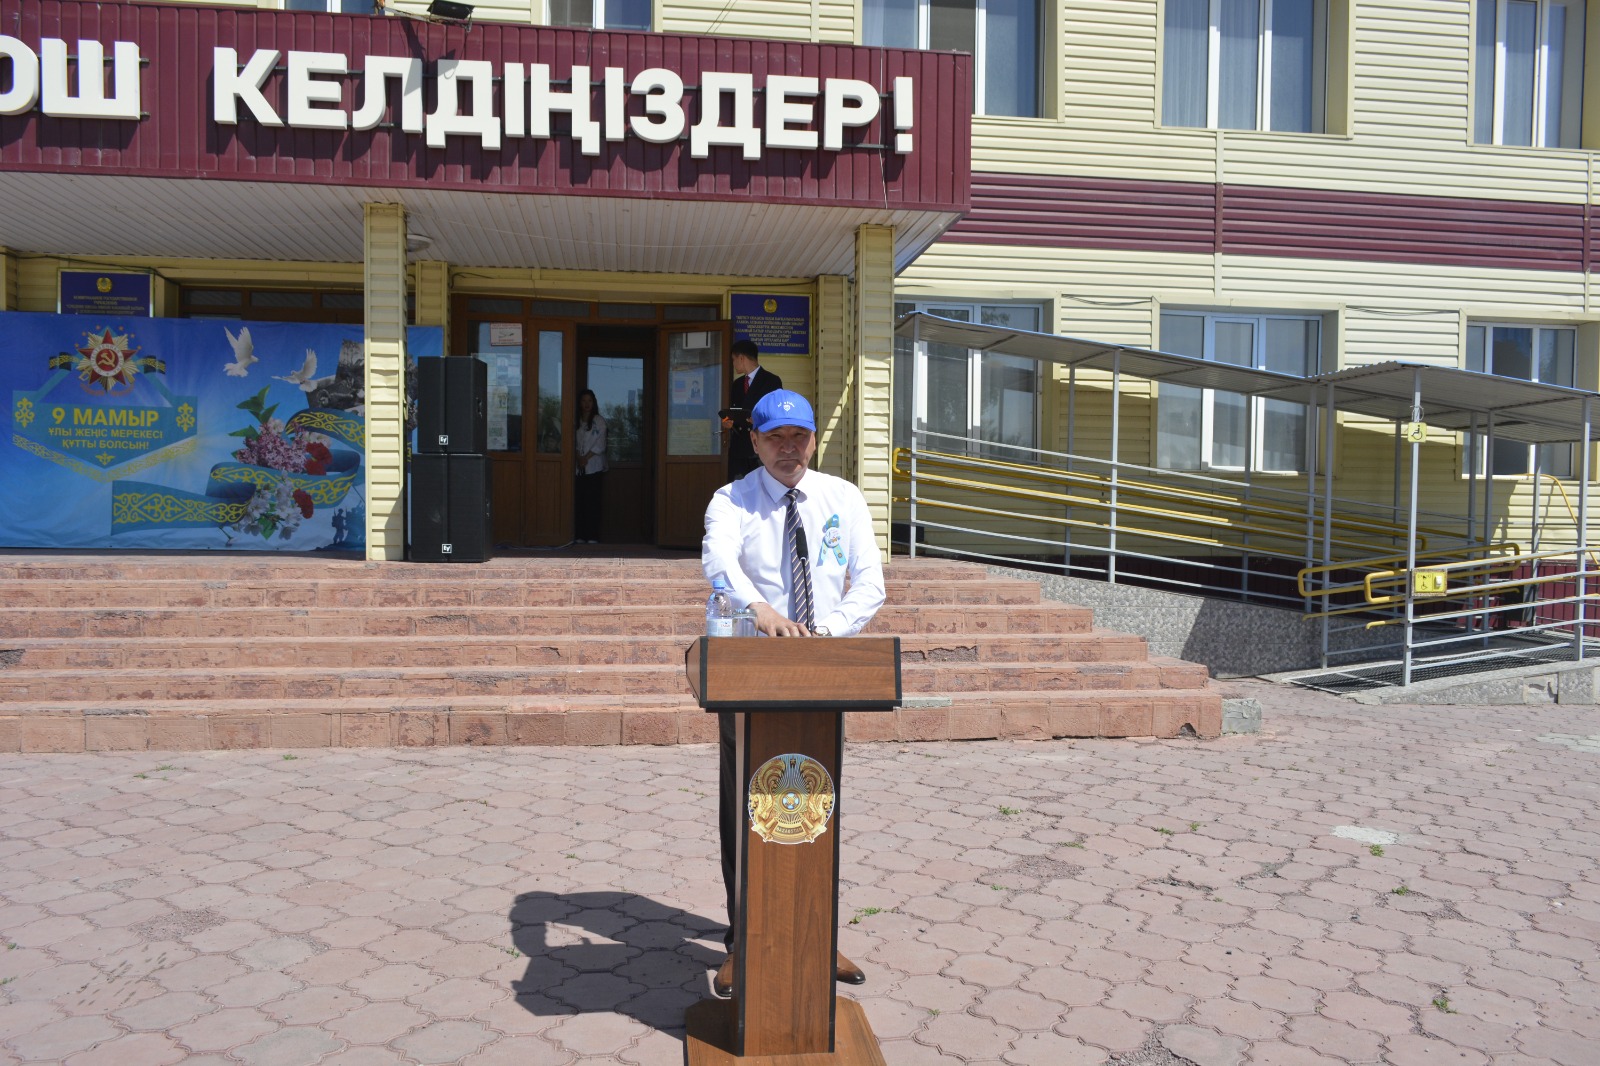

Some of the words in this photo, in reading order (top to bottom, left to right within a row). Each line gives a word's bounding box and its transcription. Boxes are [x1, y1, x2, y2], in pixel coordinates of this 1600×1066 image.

[213, 46, 914, 160] КЕЛДІҢІЗДЕР!
[52, 407, 66, 425] 9
[73, 408, 159, 427] МАМЫР
[48, 427, 72, 437] ҰЛЫ
[75, 428, 108, 439] ЖЕҢІС
[111, 429, 163, 439] МЕРЕКЕСІ
[62, 439, 96, 449] ҚҰТТЫ
[99, 440, 149, 450] БОЛСЫН!
